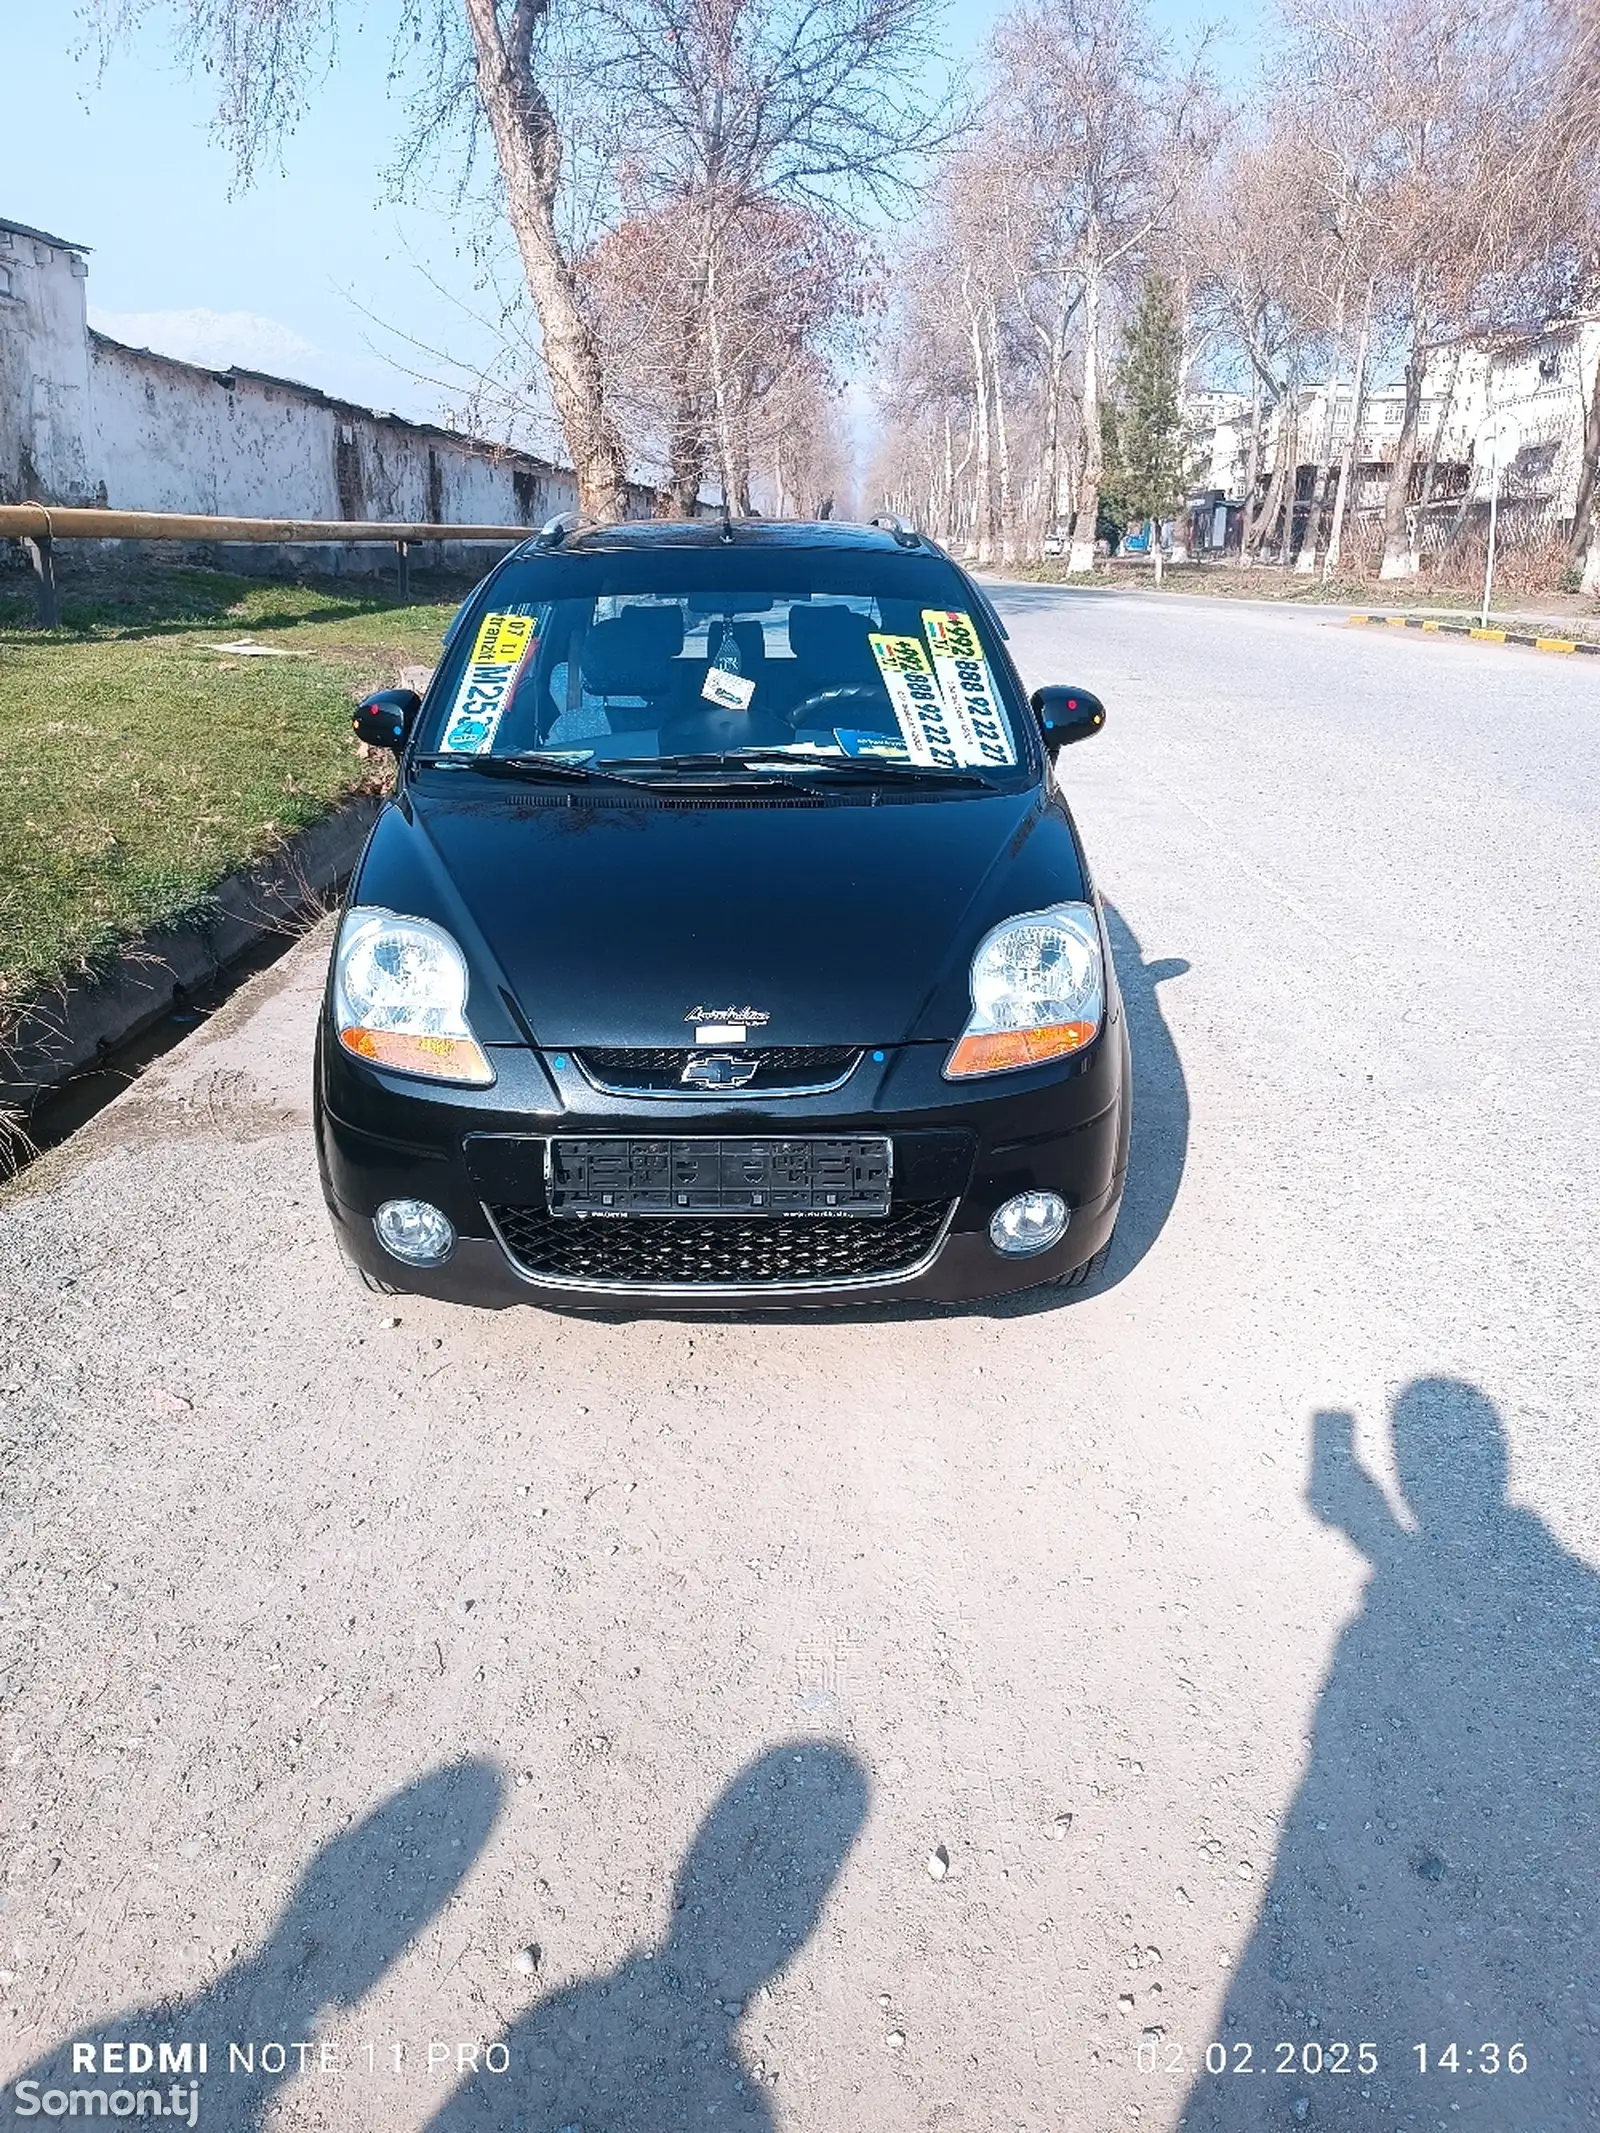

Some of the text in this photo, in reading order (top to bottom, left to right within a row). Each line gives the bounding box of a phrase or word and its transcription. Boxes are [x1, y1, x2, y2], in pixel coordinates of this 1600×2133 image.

[478, 617, 506, 660] tranzit
[507, 621, 526, 637] 07
[946, 620, 975, 658] +992
[904, 673, 935, 700] 888
[955, 660, 985, 692] 888
[915, 704, 943, 722] 92
[965, 696, 992, 716] 92
[922, 724, 951, 745] 22
[971, 718, 1000, 740] 22
[929, 747, 959, 768] 27
[979, 742, 1009, 764] 27
